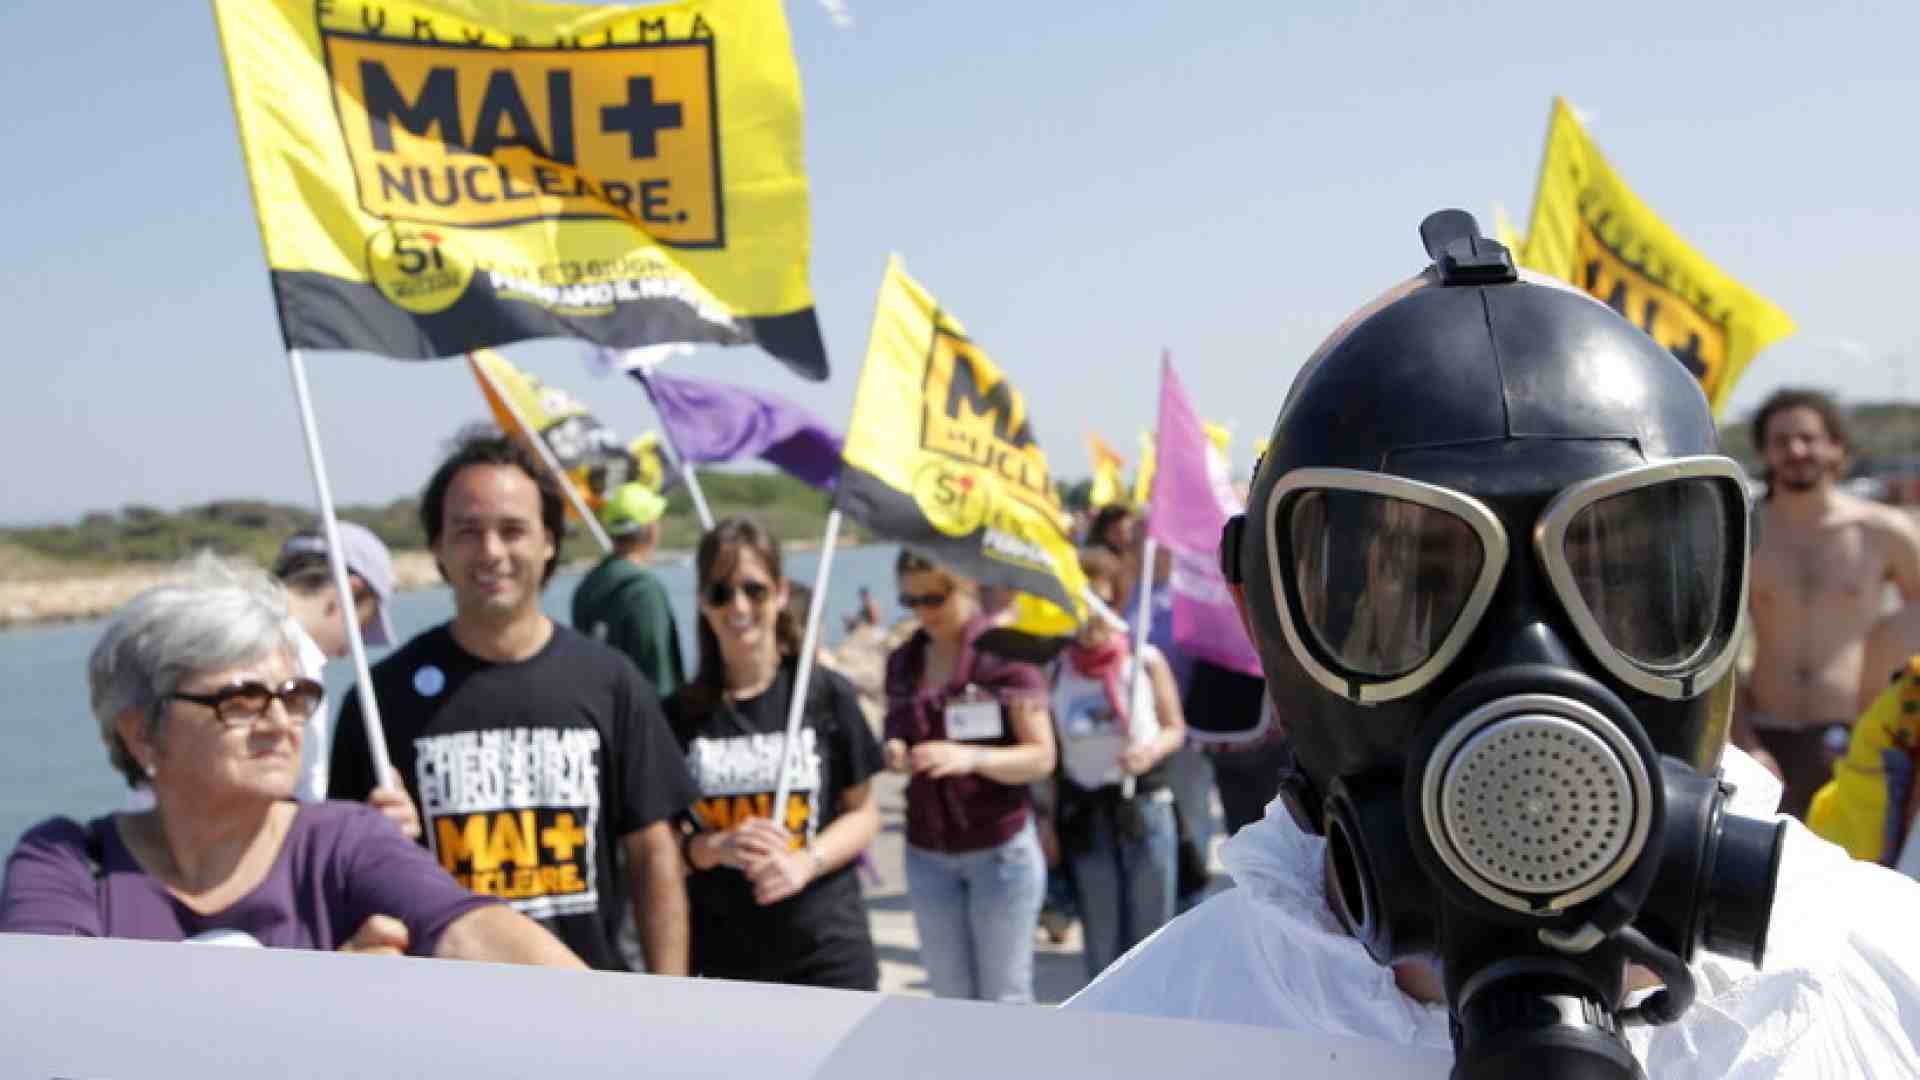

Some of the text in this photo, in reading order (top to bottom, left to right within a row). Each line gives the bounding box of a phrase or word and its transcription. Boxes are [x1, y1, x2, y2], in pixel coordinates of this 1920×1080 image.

[358, 58, 682, 168] MAI +
[436, 810, 538, 873] MAI
